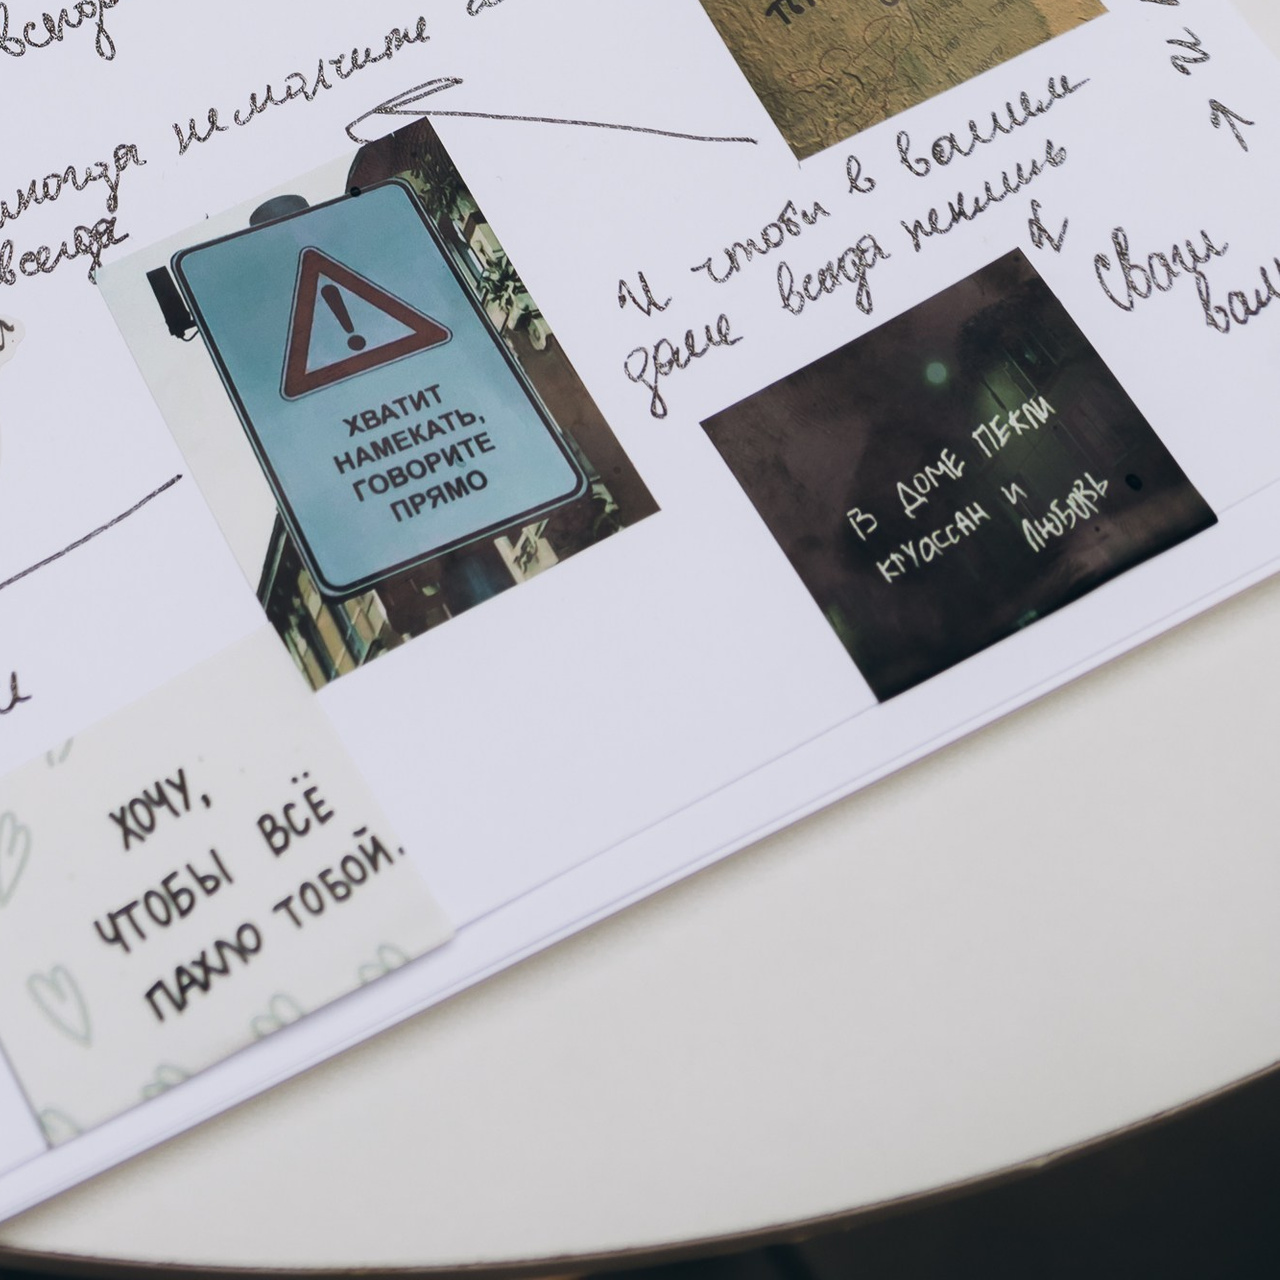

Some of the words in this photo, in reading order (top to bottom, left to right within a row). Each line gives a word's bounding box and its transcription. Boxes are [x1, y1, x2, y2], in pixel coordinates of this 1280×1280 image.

[176, 107, 228, 156] не
[233, 15, 431, 129] молчите
[617, 270, 673, 317] И
[690, 198, 833, 285] чтобы
[845, 154, 878, 195] в
[895, 72, 1091, 179] вашем
[623, 311, 745, 420] доме
[776, 232, 892, 316] всегда
[332, 408, 486, 476] НАМЕКАТЬ,
[342, 383, 446, 438] ХВАТИТ
[845, 507, 879, 541] В
[894, 448, 968, 520] ДОМЕ
[970, 392, 1057, 459] ПЕКЛИ
[350, 431, 498, 504] ГОВОРИТЕ
[388, 469, 491, 525] ПРЯМО
[1007, 481, 1029, 509] И
[1020, 471, 1112, 554] ЛЮБОВЬ
[93, 849, 235, 955] ЧТОБЫ
[257, 770, 336, 859] ВСЁ
[108, 768, 213, 852] ХОЧУ,
[142, 921, 265, 1024] ПАХЛО
[271, 825, 408, 930] ТОБОЙ.
